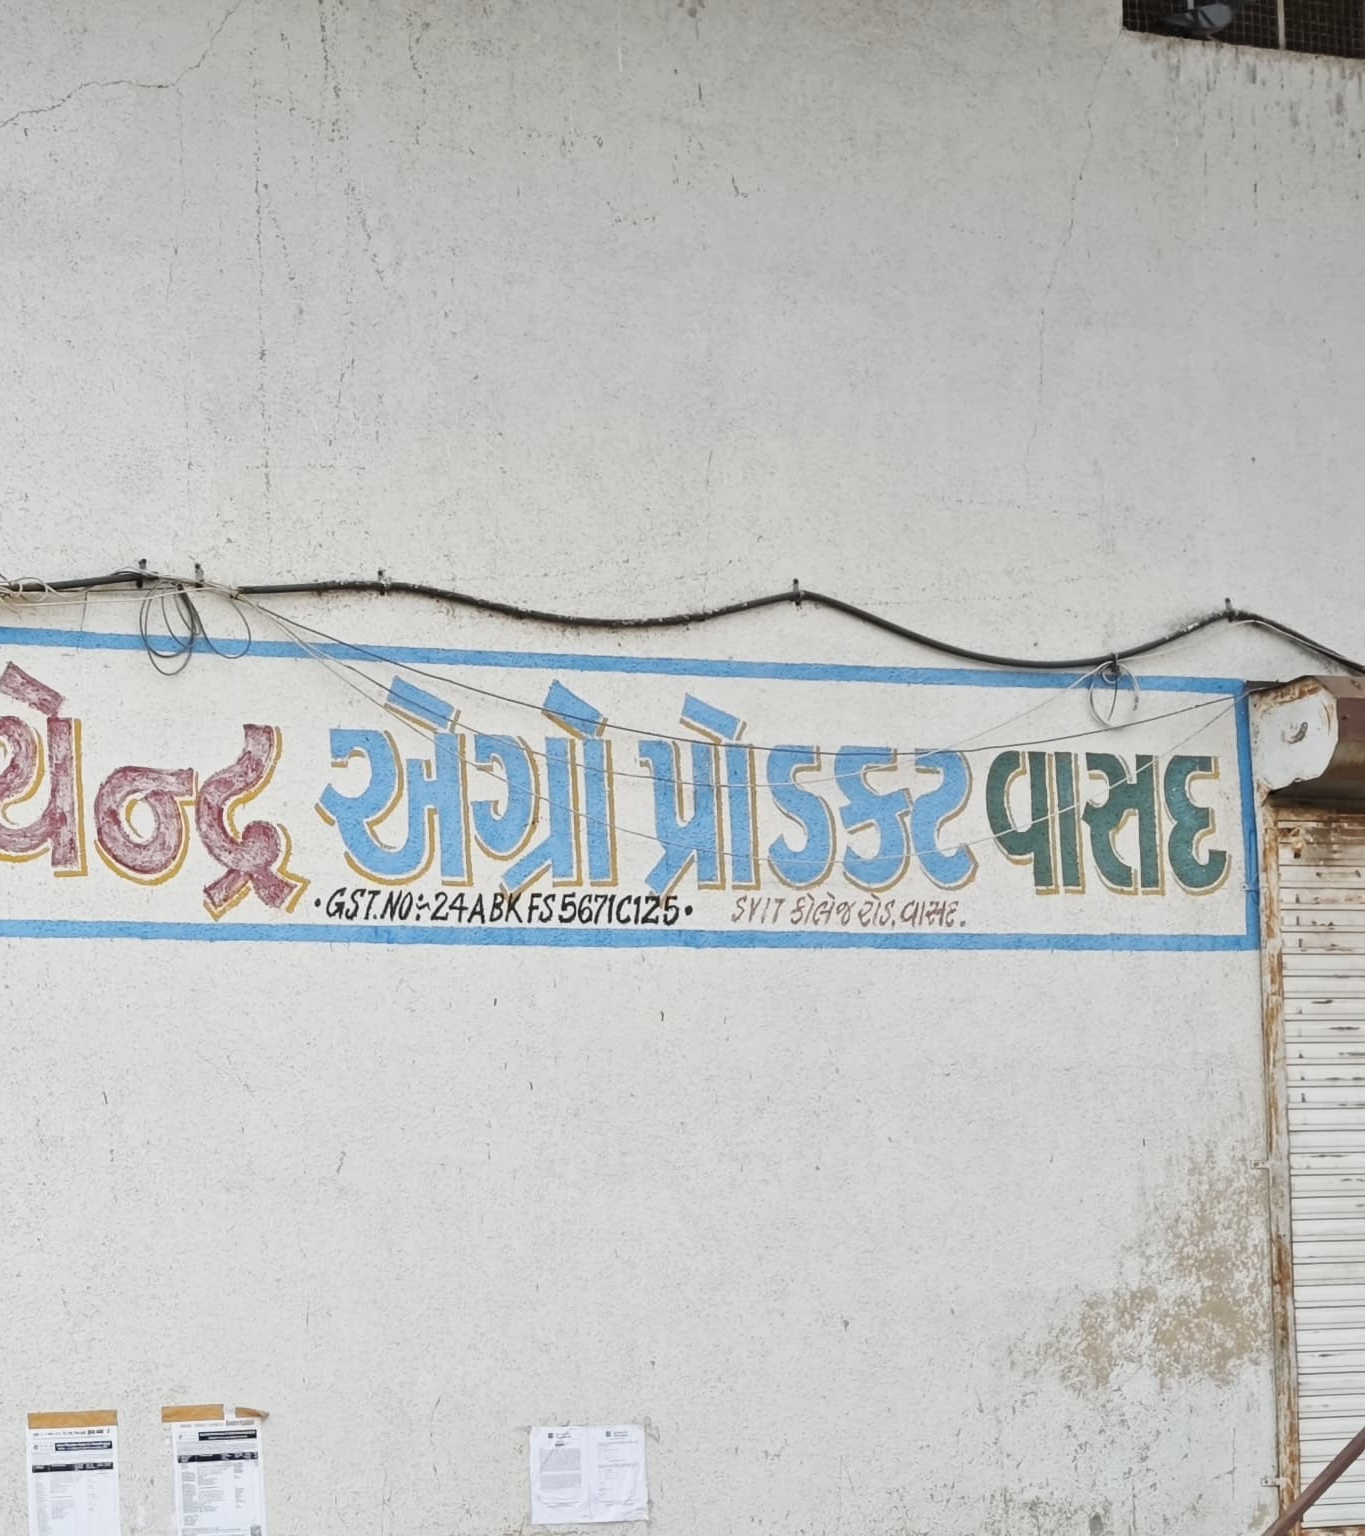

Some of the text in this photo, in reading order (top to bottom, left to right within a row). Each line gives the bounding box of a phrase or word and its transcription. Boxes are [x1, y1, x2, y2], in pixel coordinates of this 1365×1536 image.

[315, 676, 616, 896] એગ્રો
[986, 750, 1230, 895] વાસદ
[731, 895, 786, 924] SVIT
[790, 892, 856, 926] કોલેજ
